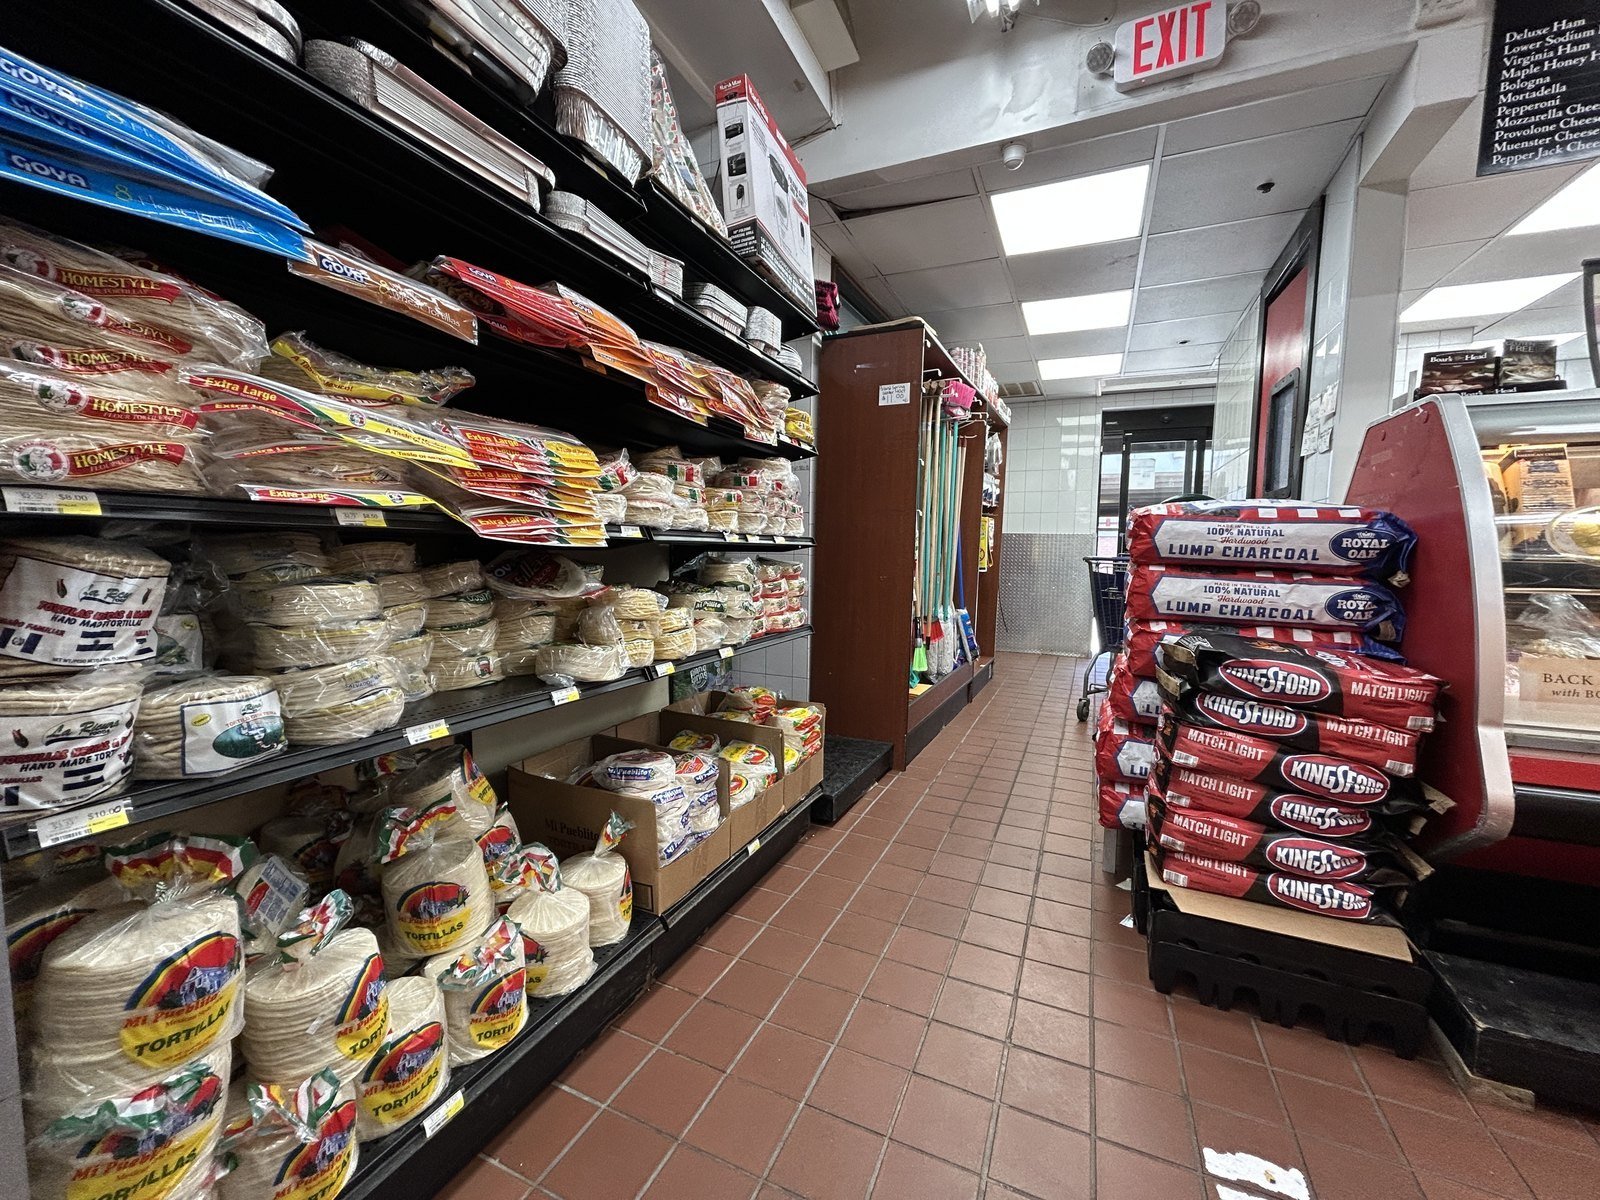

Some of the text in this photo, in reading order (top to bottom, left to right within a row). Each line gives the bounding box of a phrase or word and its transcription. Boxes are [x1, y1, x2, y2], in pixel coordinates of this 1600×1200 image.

[1133, 1, 1212, 75] EXIT
[1505, 19, 1586, 43] Deluxe Ham
[1503, 28, 1595, 55] Lower Sodium
[1503, 50, 1553, 67] Virginia
[1557, 42, 1590, 56] Ham
[1501, 64, 1540, 80] Maple
[1543, 54, 1588, 72] Honey
[0, 57, 80, 105] GOYA
[1500, 75, 1550, 92] Bologna
[1498, 82, 1567, 104] Mortadella
[1497, 95, 1560, 117] Pepperoni
[1495, 109, 1562, 129] Mozzarella
[1492, 128, 1600, 153] Muenster Cheese
[1494, 122, 1557, 141] Provolone
[1491, 140, 1600, 166] Pepper Jack Chee
[11, 154, 89, 188] GOYA
[114, 184, 132, 202] 8
[61, 270, 162, 290] HOMESTYLE
[321, 257, 368, 284] GOYA
[378, 279, 389, 295] 8
[1465, 353, 1488, 361] Head
[1509, 345, 1535, 353] FREE
[204, 377, 241, 392] Extra
[242, 383, 278, 402] Large
[92, 398, 183, 418] HOMESTYLE
[465, 432, 492, 443] Extra
[74, 444, 169, 468] HOMESTYLE
[465, 470, 494, 478] Extra
[269, 489, 332, 500] Extra Large
[1206, 527, 1285, 537] 100% NATURAL
[1220, 536, 1269, 545] Hardwood
[1168, 544, 1320, 561] LUMP CHARCOAL
[1341, 538, 1391, 549] ROYAL
[1347, 549, 1381, 559] OAK
[1203, 585, 1281, 598] 100% NATURAL
[1217, 595, 1265, 605] Hardwood
[1166, 600, 1316, 621] LUMP CHARCOAL
[1343, 610, 1375, 620] OAK
[1543, 673, 1594, 686] BACK
[1351, 681, 1432, 702] MATCH LIGHT
[1551, 689, 1580, 698] with
[1203, 694, 1297, 730] KINGSFORD
[46, 723, 72, 739] La
[1326, 718, 1413, 747] MATCH LIGHT
[1187, 728, 1265, 761] MATCH LIGHT
[20, 756, 92, 773] HAND MADE
[1130, 764, 1149, 777] LU
[1178, 769, 1254, 801] MATCH LIGHT
[1290, 761, 1385, 795] KINGSFORD
[87, 805, 123, 821] $10.00
[559, 822, 600, 842] Pueblito
[1173, 813, 1249, 847] MATCH LIGHT
[1214, 861, 1249, 878] LIGHT
[1277, 877, 1369, 909] KINGSFORD
[405, 921, 465, 941] TORTILLAS
[123, 991, 222, 1029] Mi Pueblito
[470, 1017, 483, 1025] Mi
[337, 1028, 354, 1039] Mi
[363, 1067, 425, 1098] Mi Pueblito
[372, 1067, 439, 1117] TORTILLAS
[72, 1166, 101, 1181] Mi
[92, 1147, 198, 1200] ORTILLAS
[273, 1184, 293, 1200] Mi
